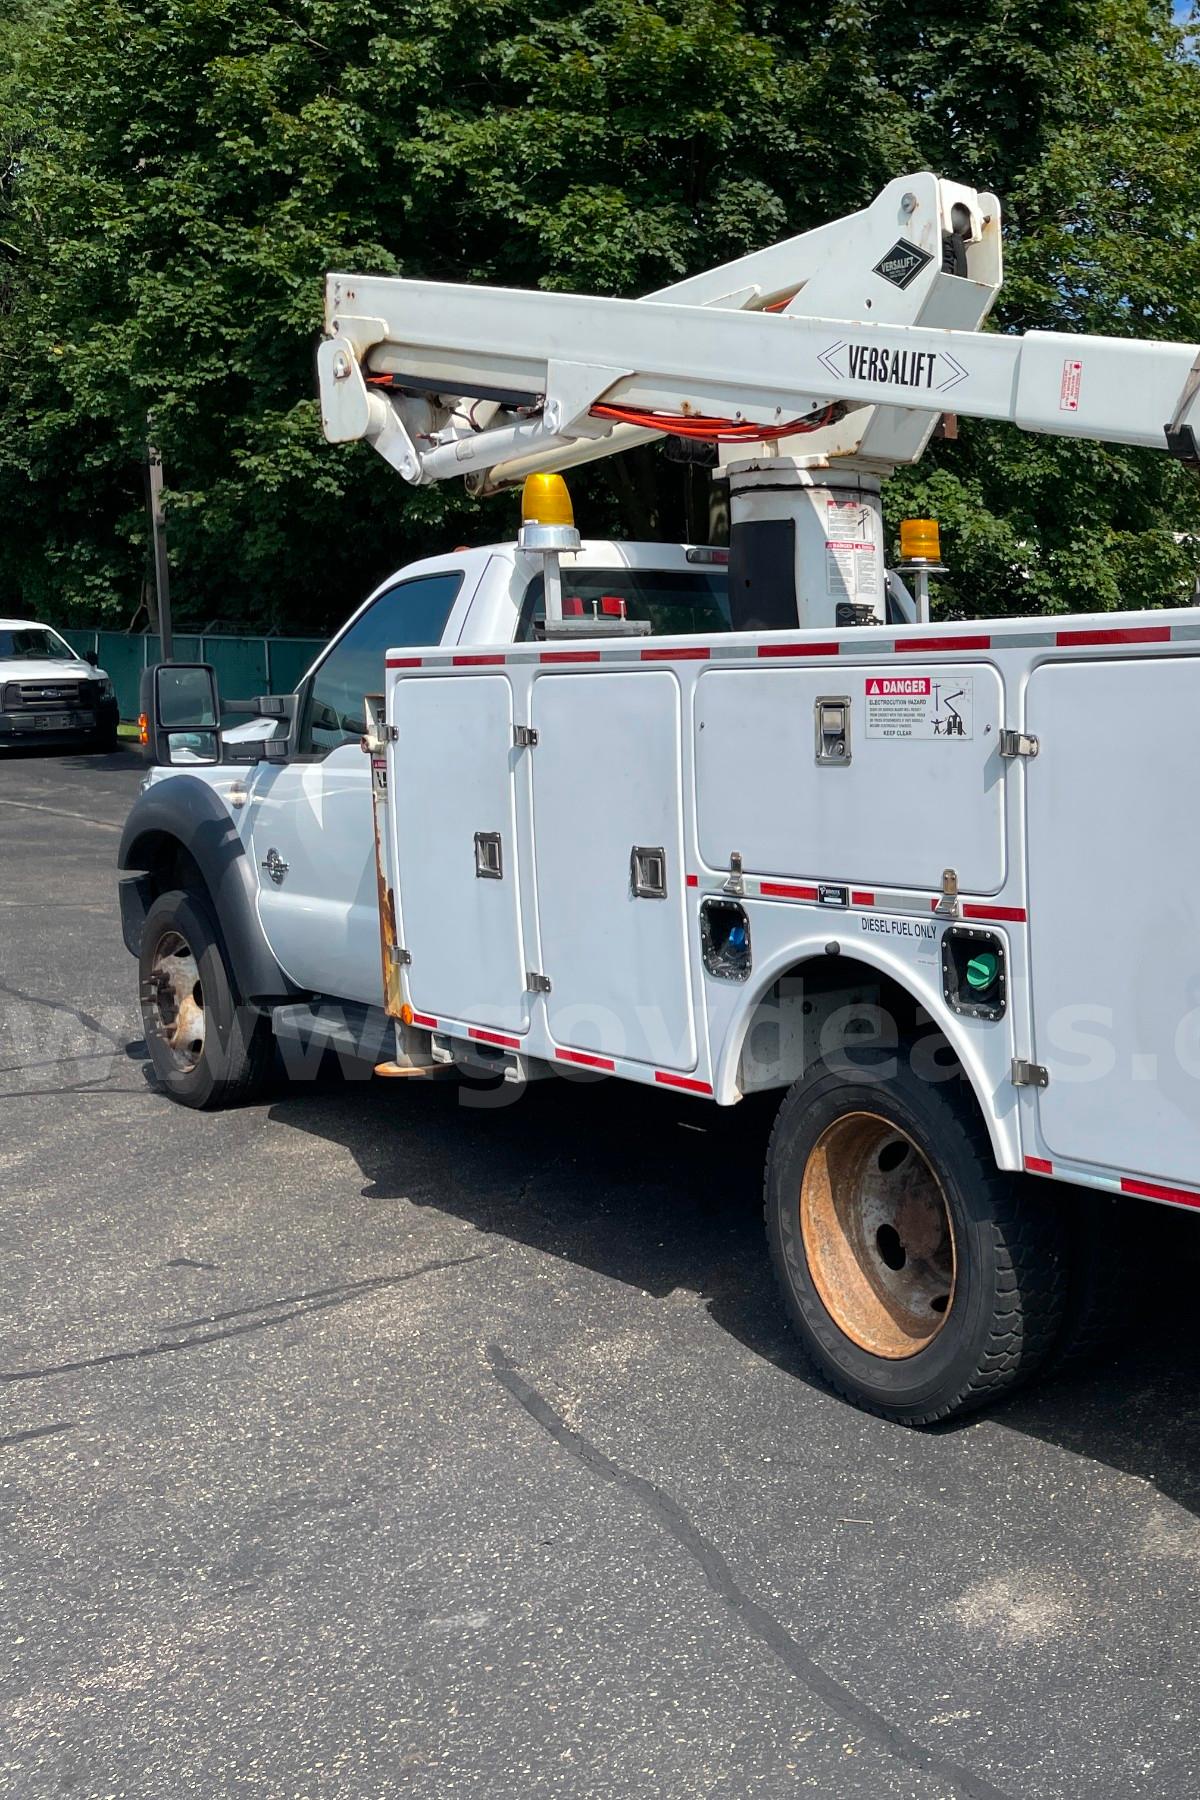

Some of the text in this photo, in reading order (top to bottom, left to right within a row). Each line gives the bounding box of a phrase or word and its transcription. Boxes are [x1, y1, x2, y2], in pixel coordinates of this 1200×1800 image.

[881, 256, 913, 273] VERSALIFT
[849, 344, 936, 388] VERSALIFT
[882, 680, 926, 694] DANGER
[861, 917, 937, 939] DIESEL FUEL ONLY
